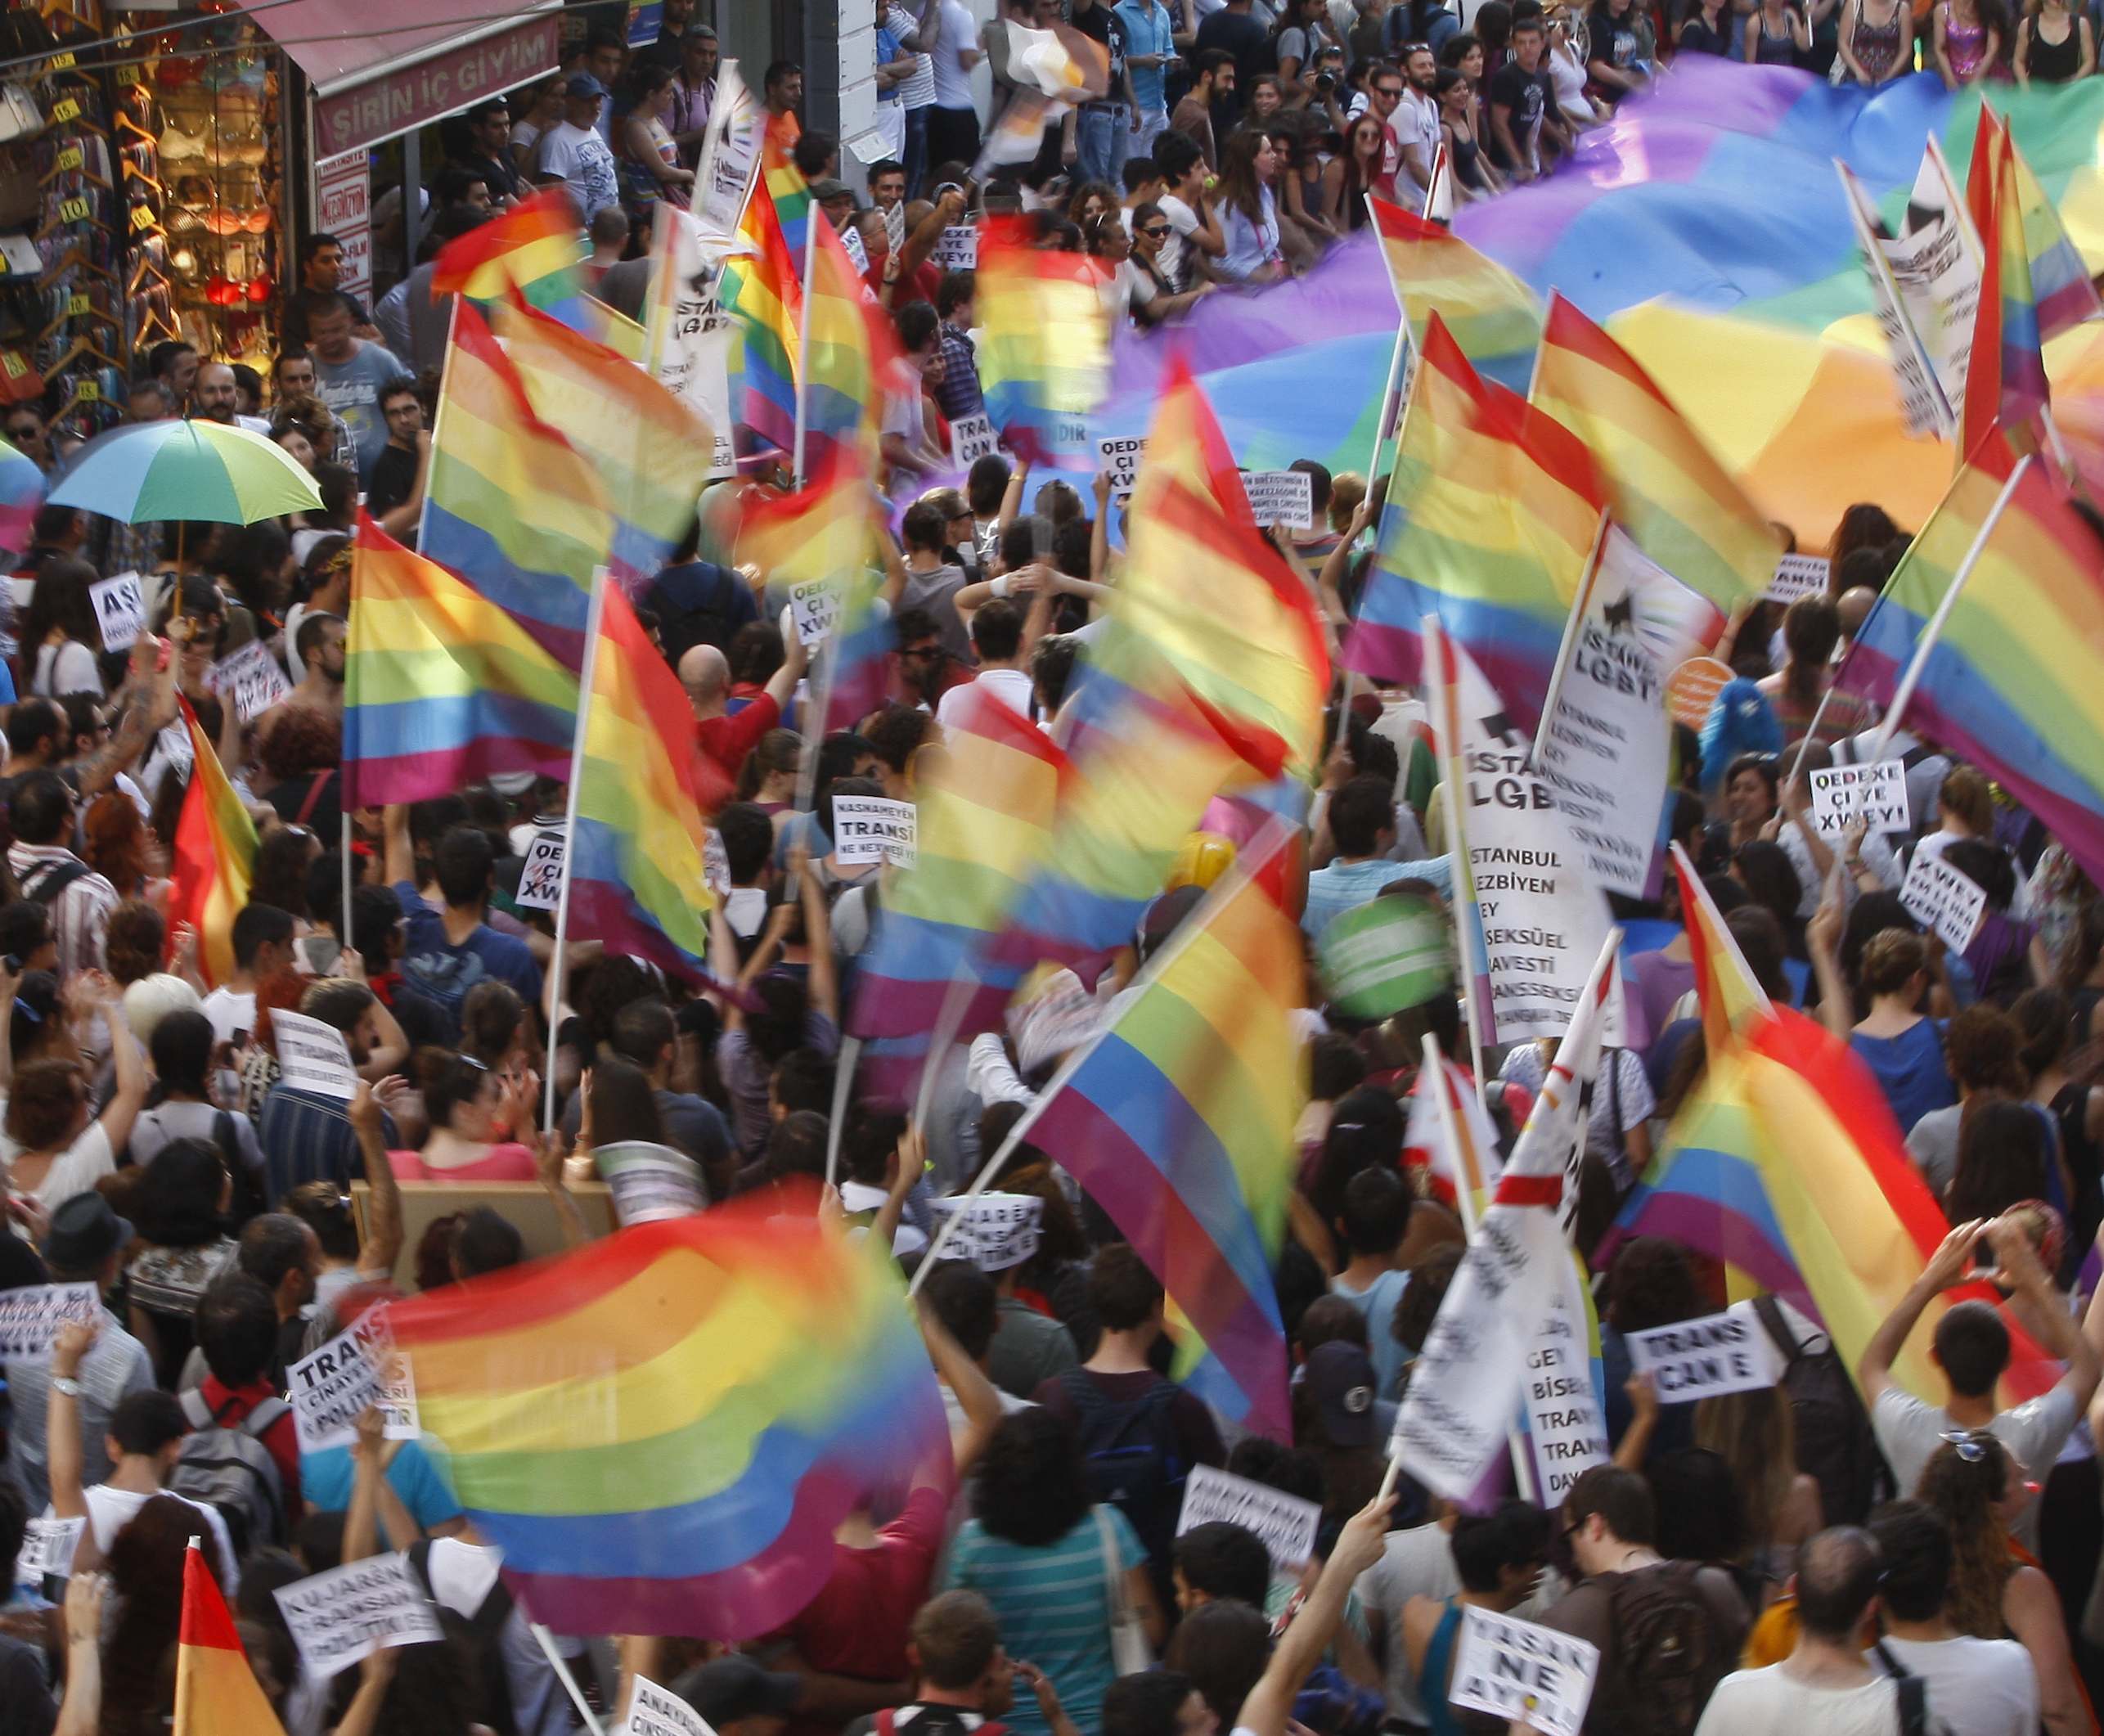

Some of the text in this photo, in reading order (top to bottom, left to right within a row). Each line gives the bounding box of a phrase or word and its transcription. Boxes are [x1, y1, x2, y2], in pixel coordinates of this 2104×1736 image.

[332, 33, 546, 149] ŞİRİN İÇ GİYİM
[63, 204, 83, 217] 10
[945, 229, 972, 238] EXE
[1102, 439, 1148, 456] QEDE
[1816, 766, 1899, 790] QEDEXE
[1469, 778, 1555, 810] LGB
[1832, 785, 1886, 809] ÇI YE
[839, 821, 915, 843] TRANSÎ
[1472, 846, 1562, 867] STANBUL
[1475, 872, 1555, 895] EZBİYEN
[1481, 902, 1499, 918] EY
[1486, 928, 1569, 950] SEKSÜEL
[297, 1311, 384, 1387] TRANS
[1642, 1319, 1749, 1358] TRANS
[1657, 1352, 1751, 1392] CAN E
[1549, 1470, 1580, 1492] DAY
[1489, 1650, 1562, 1694] NE
